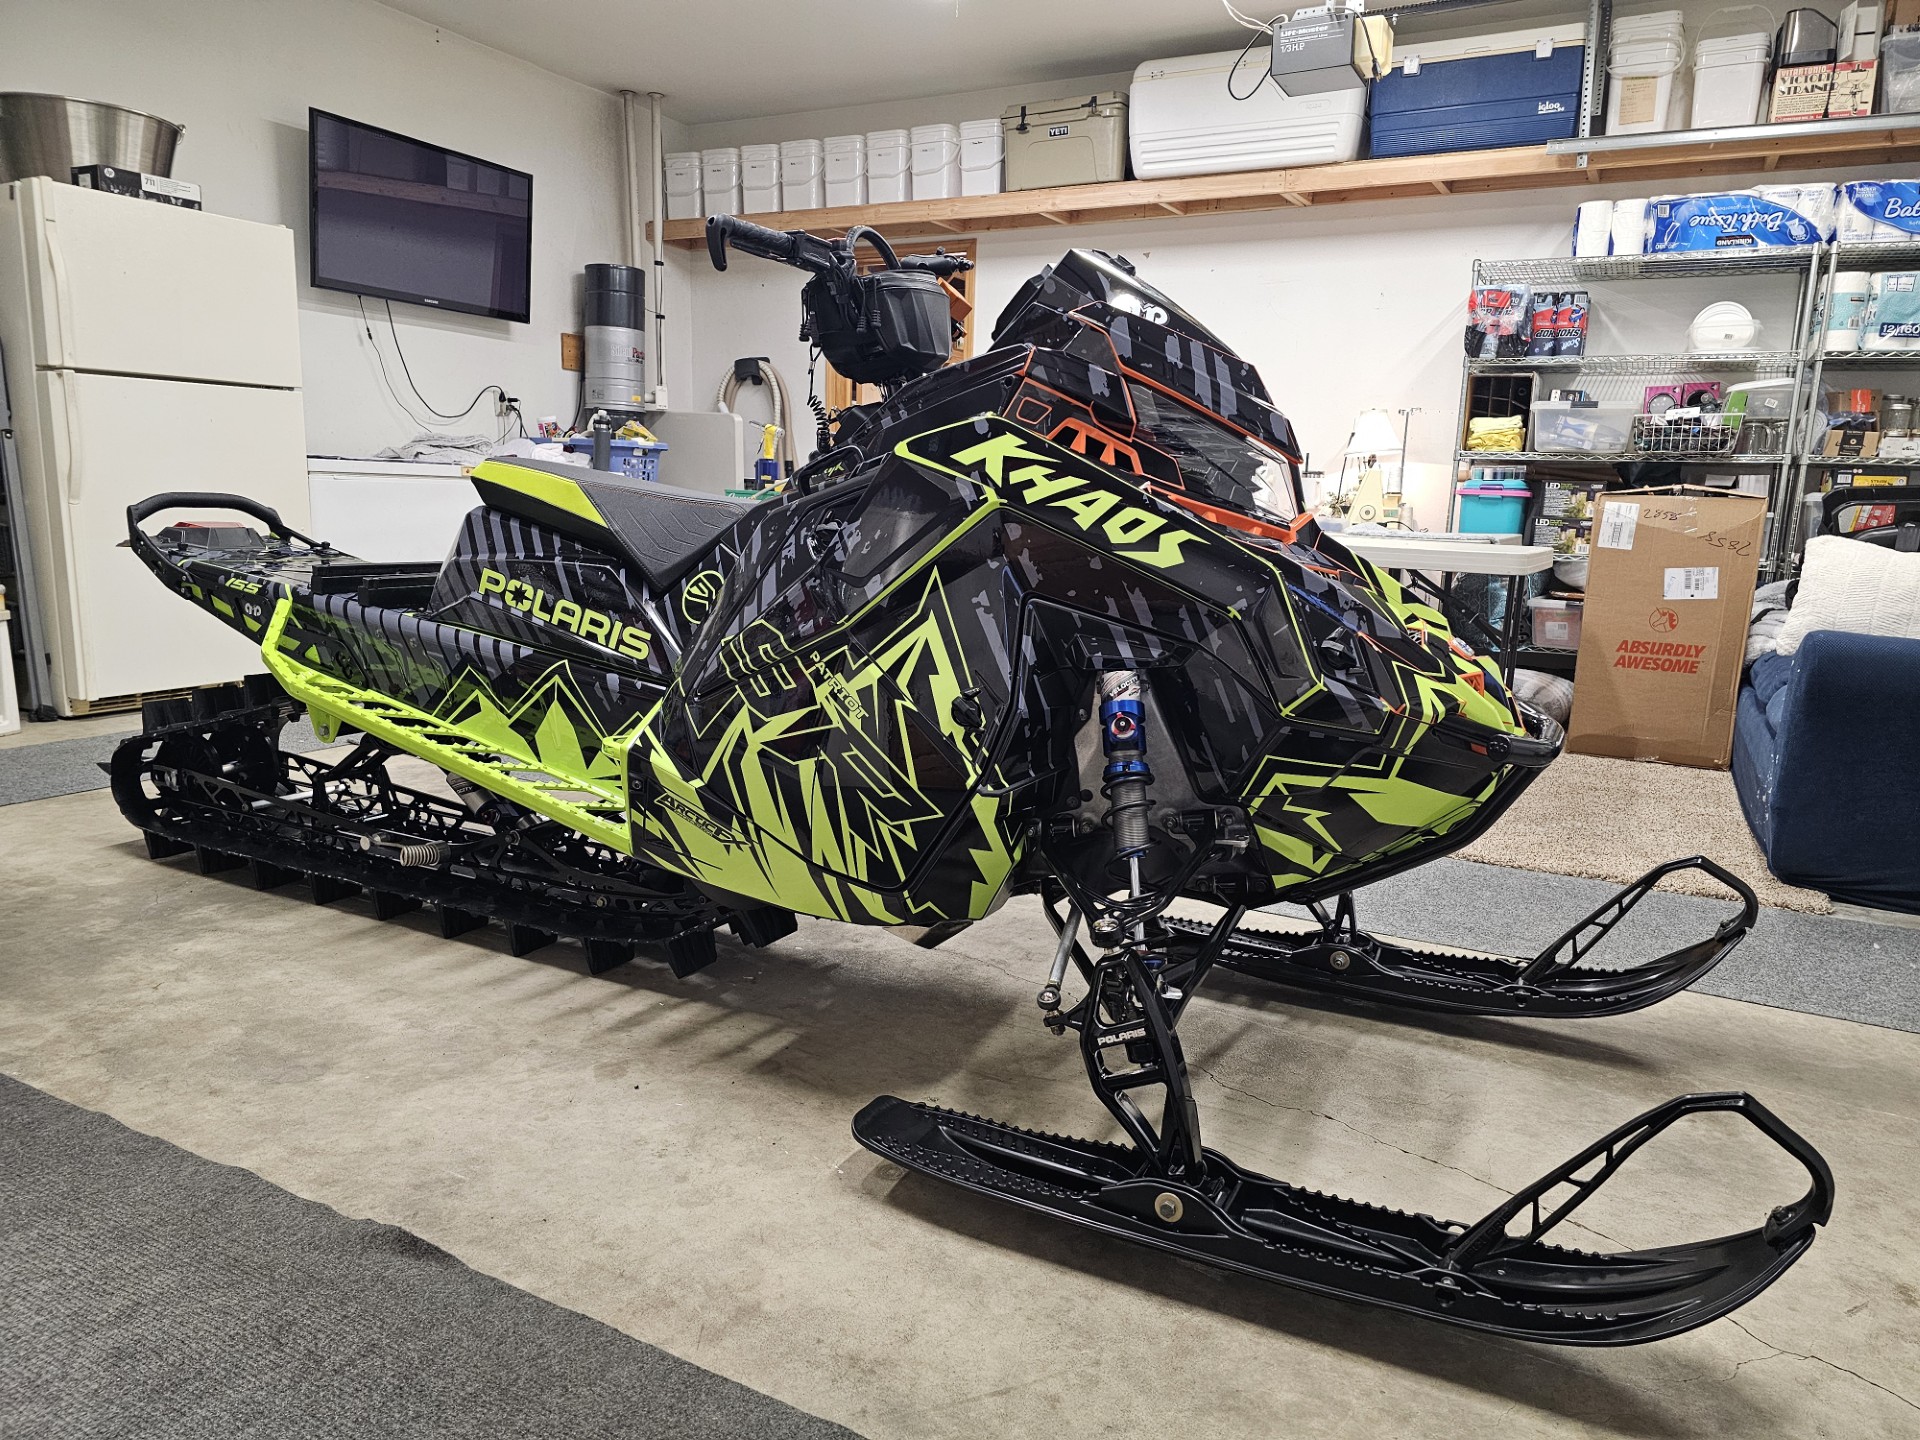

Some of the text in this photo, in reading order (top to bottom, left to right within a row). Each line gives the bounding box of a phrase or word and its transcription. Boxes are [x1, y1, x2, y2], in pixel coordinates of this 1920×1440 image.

[1280, 25, 1329, 37] Lift-Master
[1538, 101, 1560, 112] igloo
[1050, 127, 1068, 136] YETI
[144, 178, 156, 186] 711
[1884, 197, 1920, 218] Bat
[1688, 211, 1785, 233] Bath Tissue
[1716, 237, 1753, 247] KIRKLAND
[949, 431, 1211, 569] KHAOS
[1535, 518, 1549, 526] LED
[478, 567, 652, 660] POLARIS
[1615, 639, 1706, 659] ABSURDLY
[1613, 655, 1700, 674] AWESOME
[809, 651, 869, 720] PATRIOT
[1097, 1027, 1146, 1046] POLARIS
